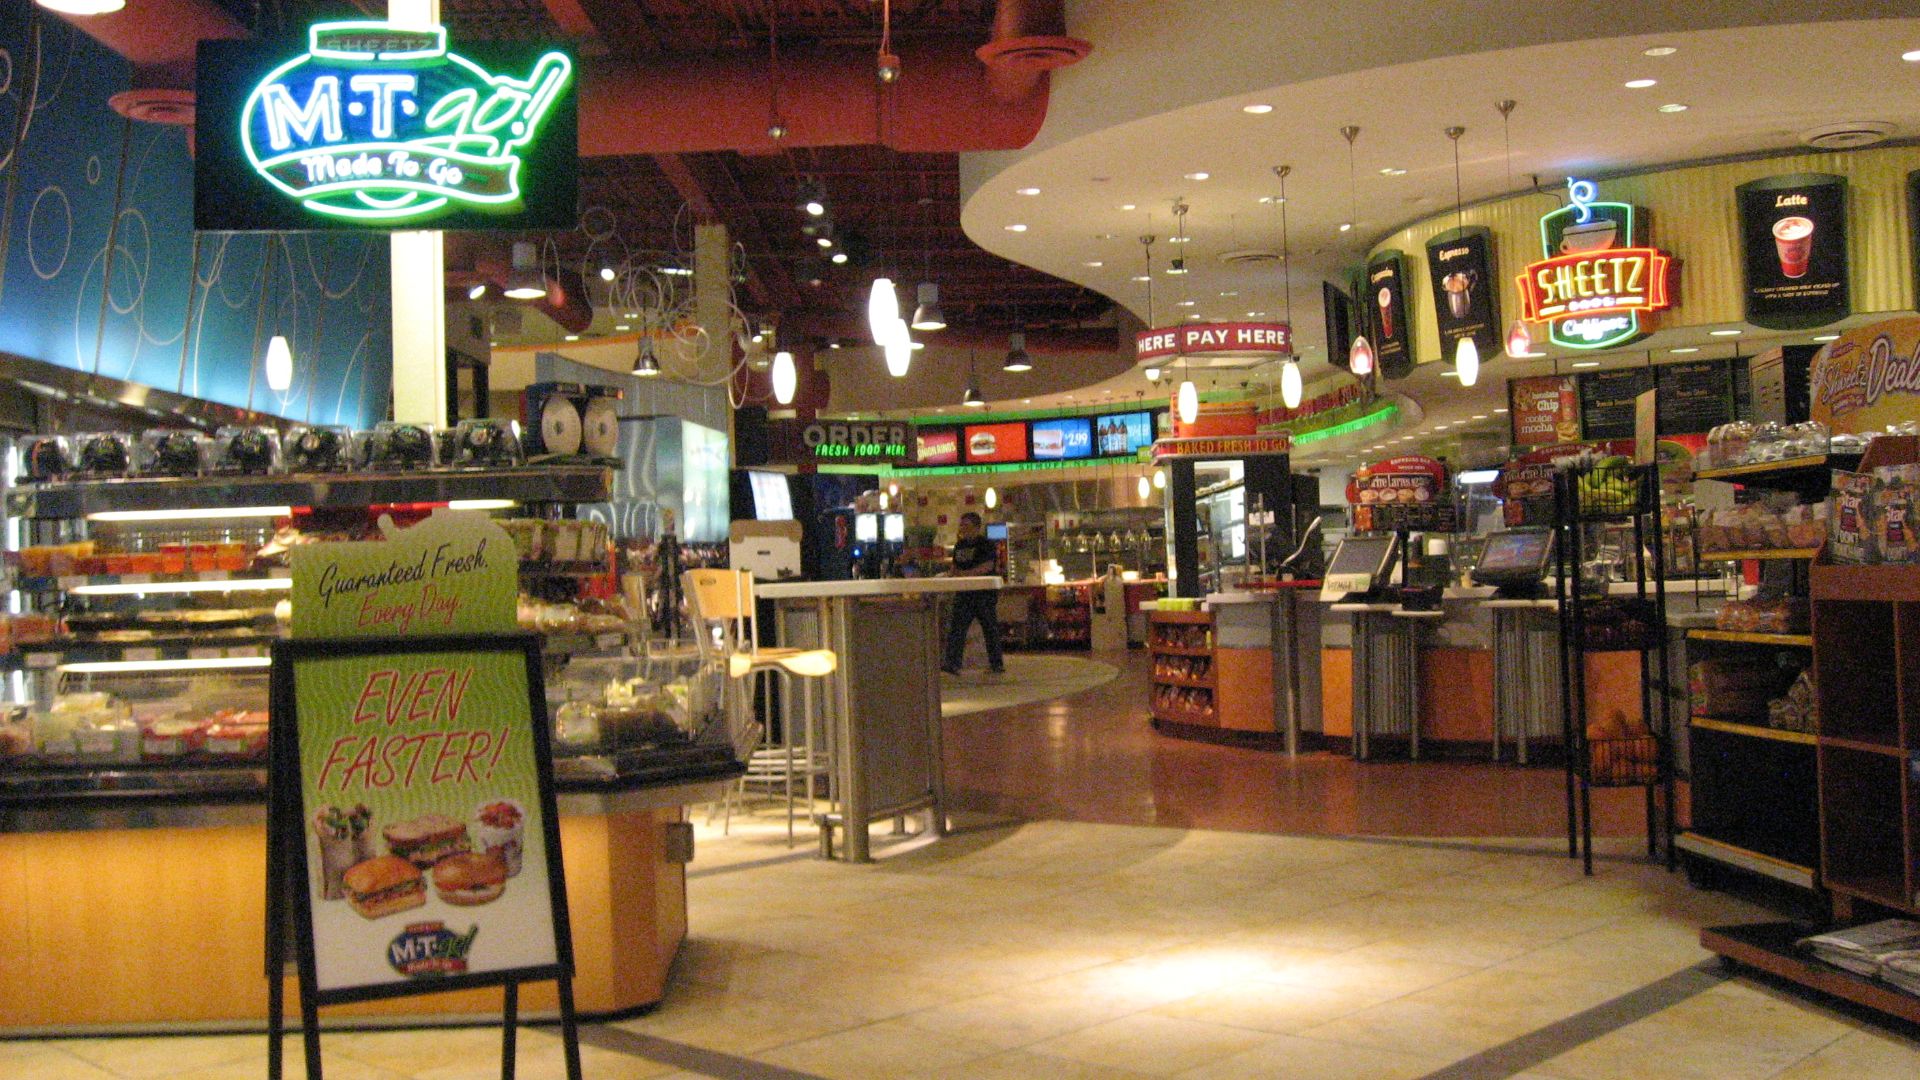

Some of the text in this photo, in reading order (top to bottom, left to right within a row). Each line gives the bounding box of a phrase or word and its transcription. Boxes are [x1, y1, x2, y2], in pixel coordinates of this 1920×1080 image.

[325, 38, 433, 51] SHEETZ
[301, 151, 463, 185] Made To Go
[1775, 194, 1808, 208] Latte
[1537, 257, 1646, 305] SHEETZ
[1138, 329, 1285, 353] HERE PAY HERE
[1537, 399, 1559, 412] Chip
[1525, 414, 1552, 423] cookie
[803, 424, 905, 446] ORDER
[1522, 423, 1554, 433] mocha
[815, 444, 906, 456] FRESH FOOD HERE
[1177, 439, 1288, 454] BAKED FRESH TO GO
[955, 464, 998, 474] PANINI
[318, 537, 488, 608] Guaranteed Fresh.
[358, 582, 463, 634] Every Day.
[353, 667, 475, 727] EVEN
[318, 727, 510, 791] FASTER!
